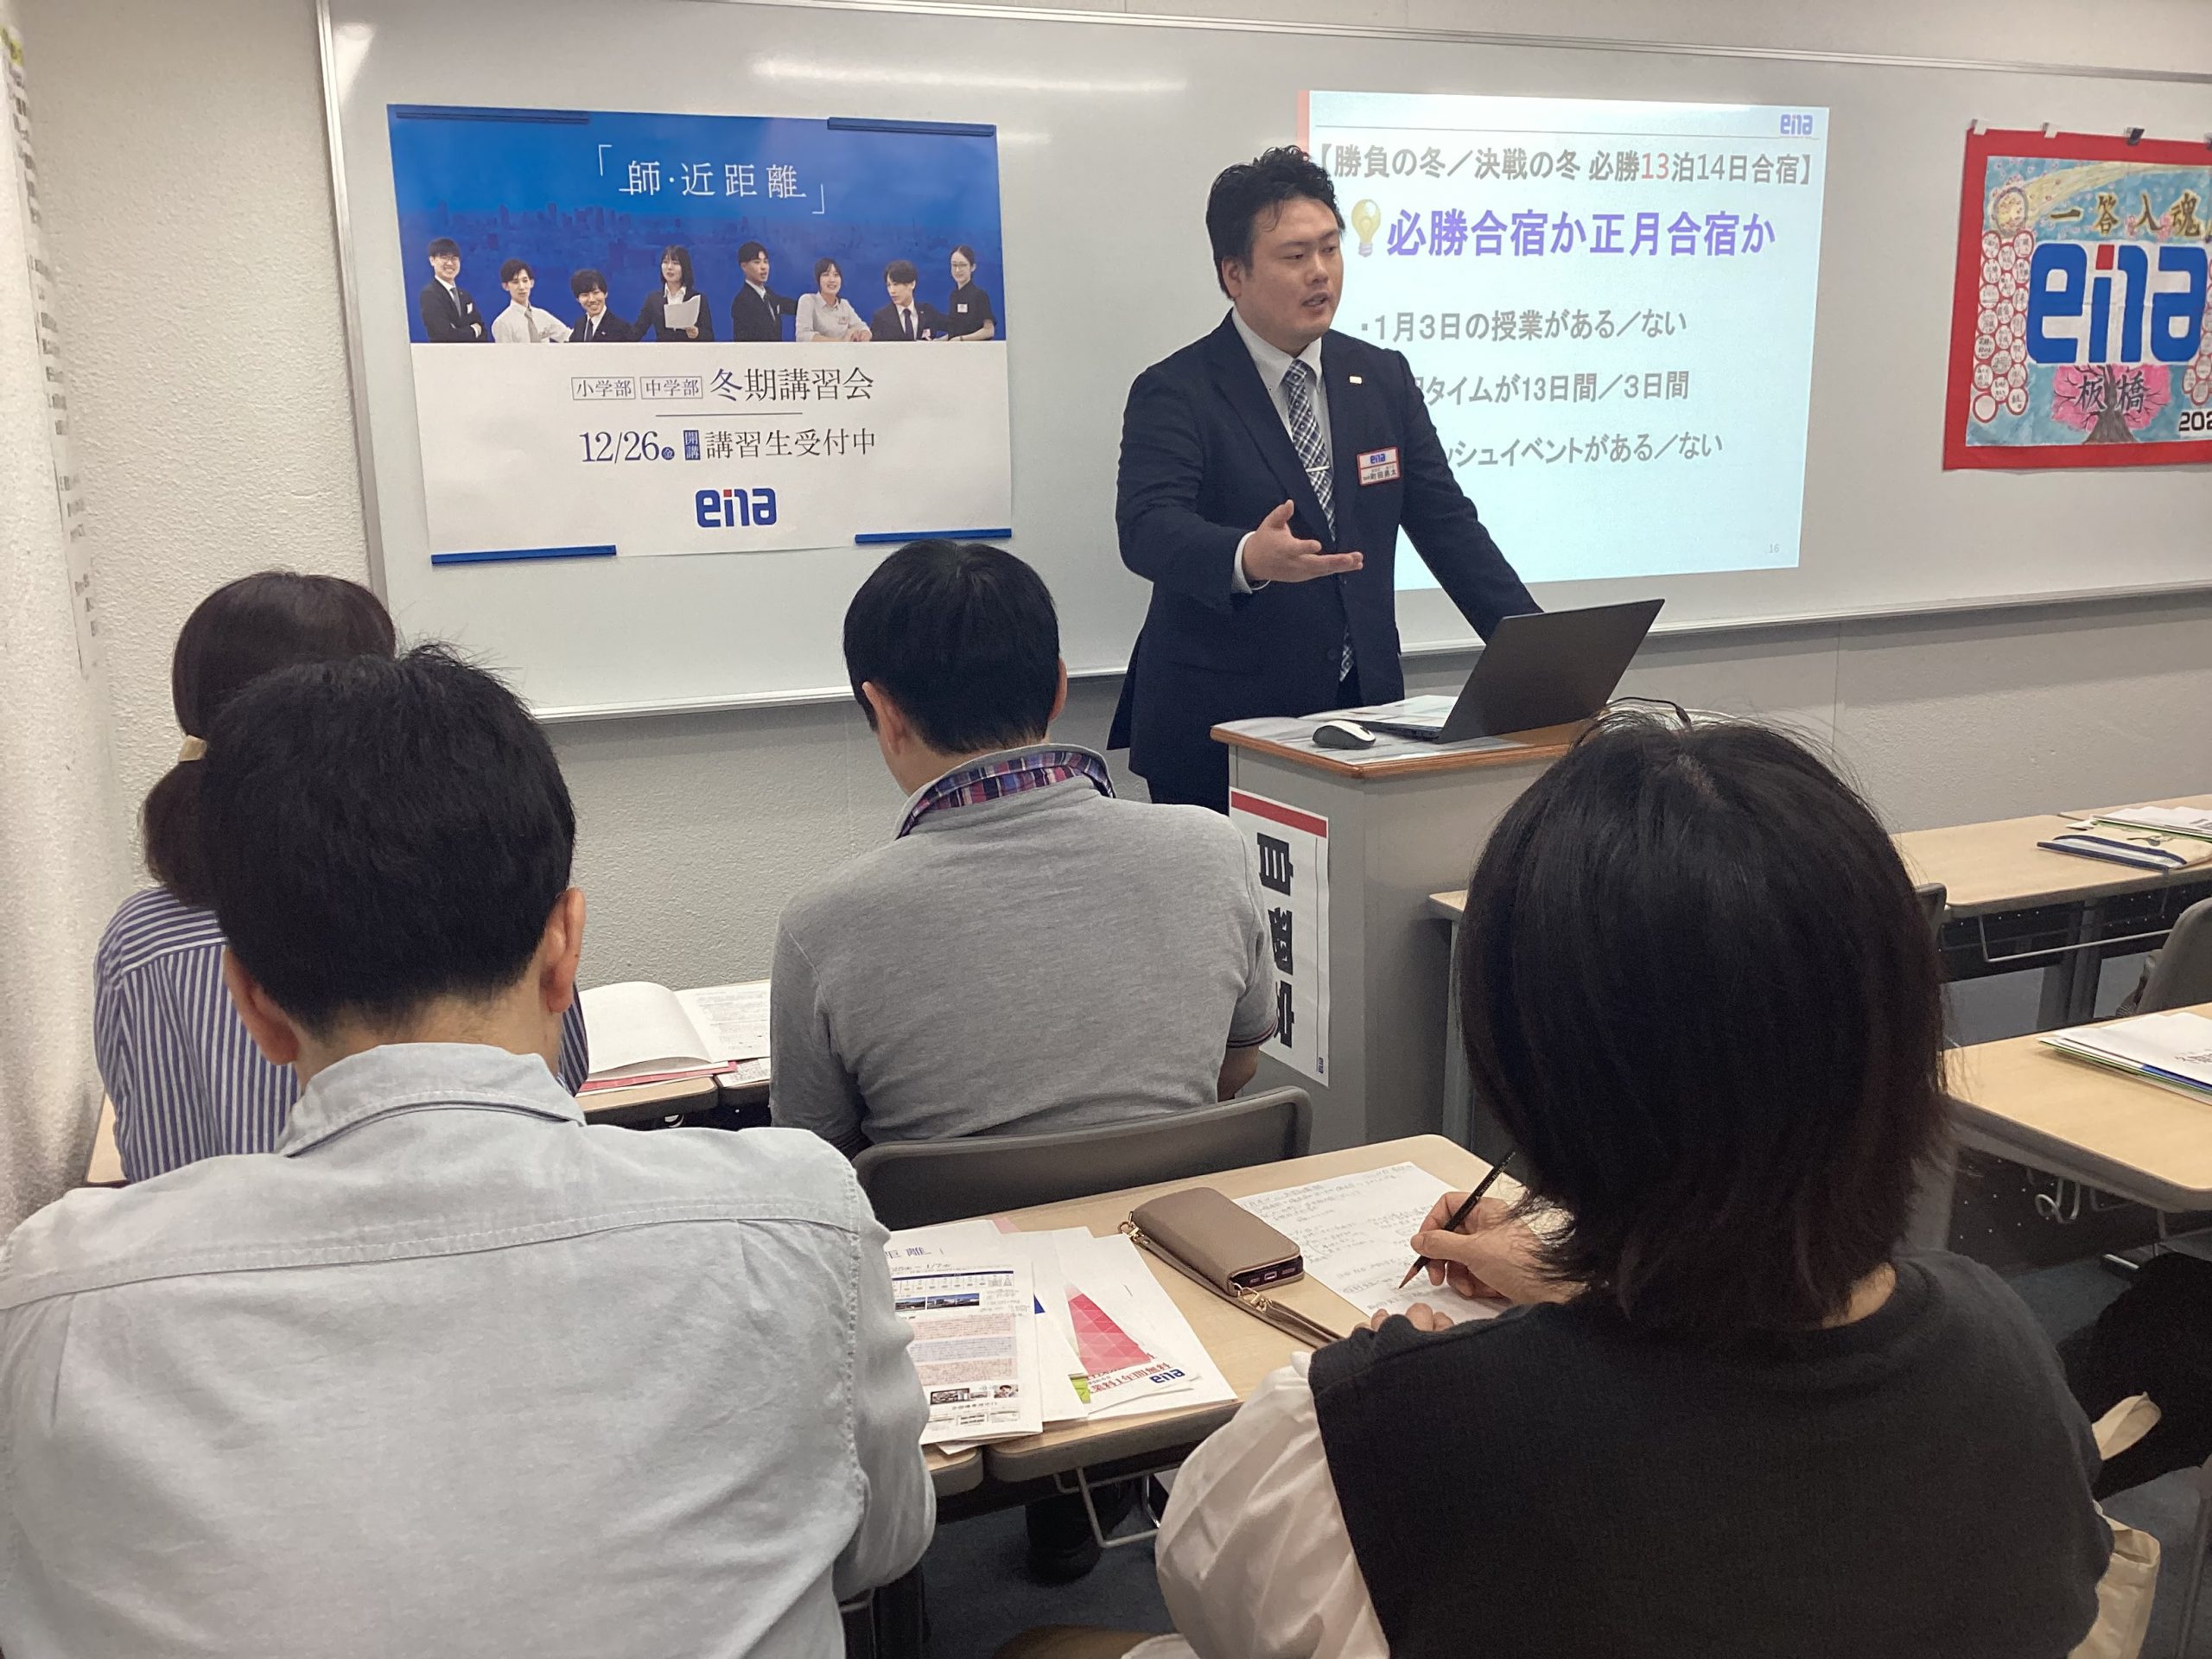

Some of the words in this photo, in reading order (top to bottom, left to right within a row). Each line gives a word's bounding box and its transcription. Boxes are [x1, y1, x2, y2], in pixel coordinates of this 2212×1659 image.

[1387, 207, 1776, 257] 必勝合宿か正月合宿か
[575, 378, 632, 398] 小学部
[645, 378, 701, 398] 中学部
[709, 366, 874, 403] 冬期講習会
[2077, 373, 2150, 415] 板橋
[705, 429, 876, 458] 講習生受付中
